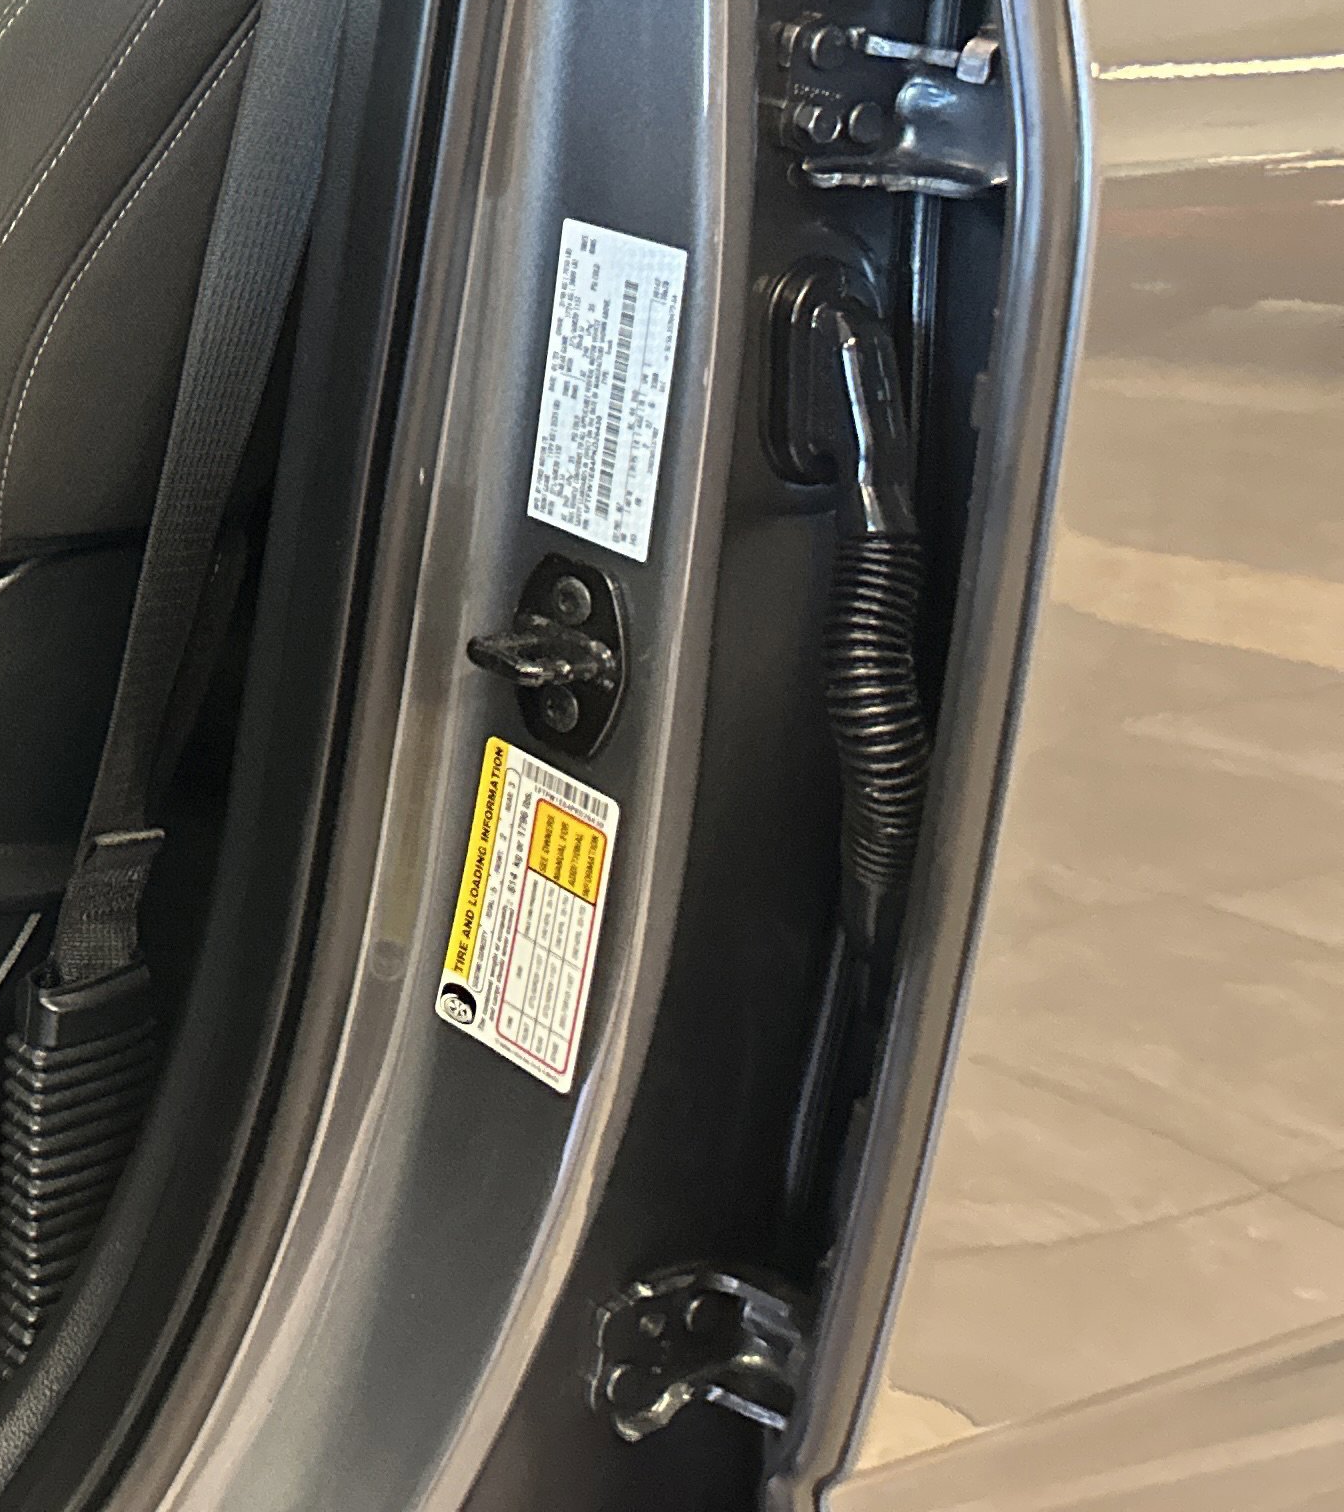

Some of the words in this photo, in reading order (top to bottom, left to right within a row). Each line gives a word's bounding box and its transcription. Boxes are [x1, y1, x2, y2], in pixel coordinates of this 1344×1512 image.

[481, 745, 504, 843] INFORMATION
[468, 844, 487, 907] LOADING
[462, 907, 475, 939] AND
[454, 939, 469, 975] TIRE
